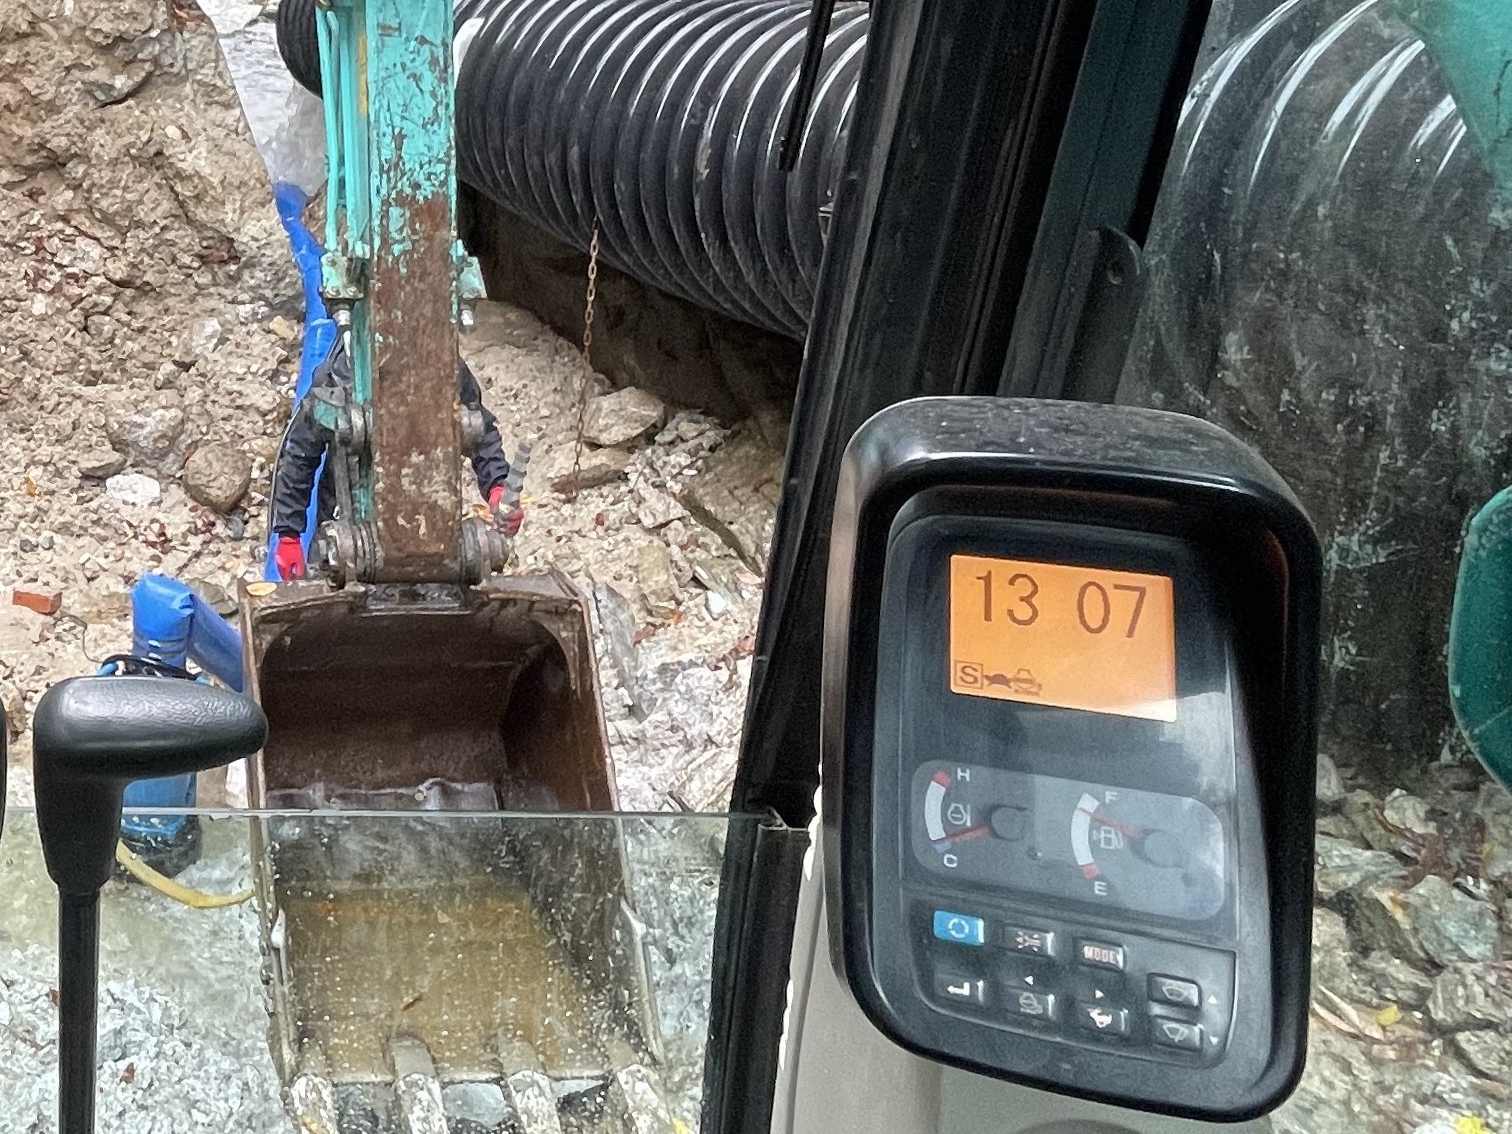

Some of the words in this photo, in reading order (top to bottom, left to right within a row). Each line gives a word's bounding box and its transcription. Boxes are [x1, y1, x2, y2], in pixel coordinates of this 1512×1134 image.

[975, 570, 1039, 626] 13
[1076, 581, 1148, 639] 07
[959, 665, 979, 685] S
[956, 768, 970, 782] H
[1104, 791, 1118, 804] F
[943, 854, 958, 868] C
[1094, 881, 1108, 896] E
